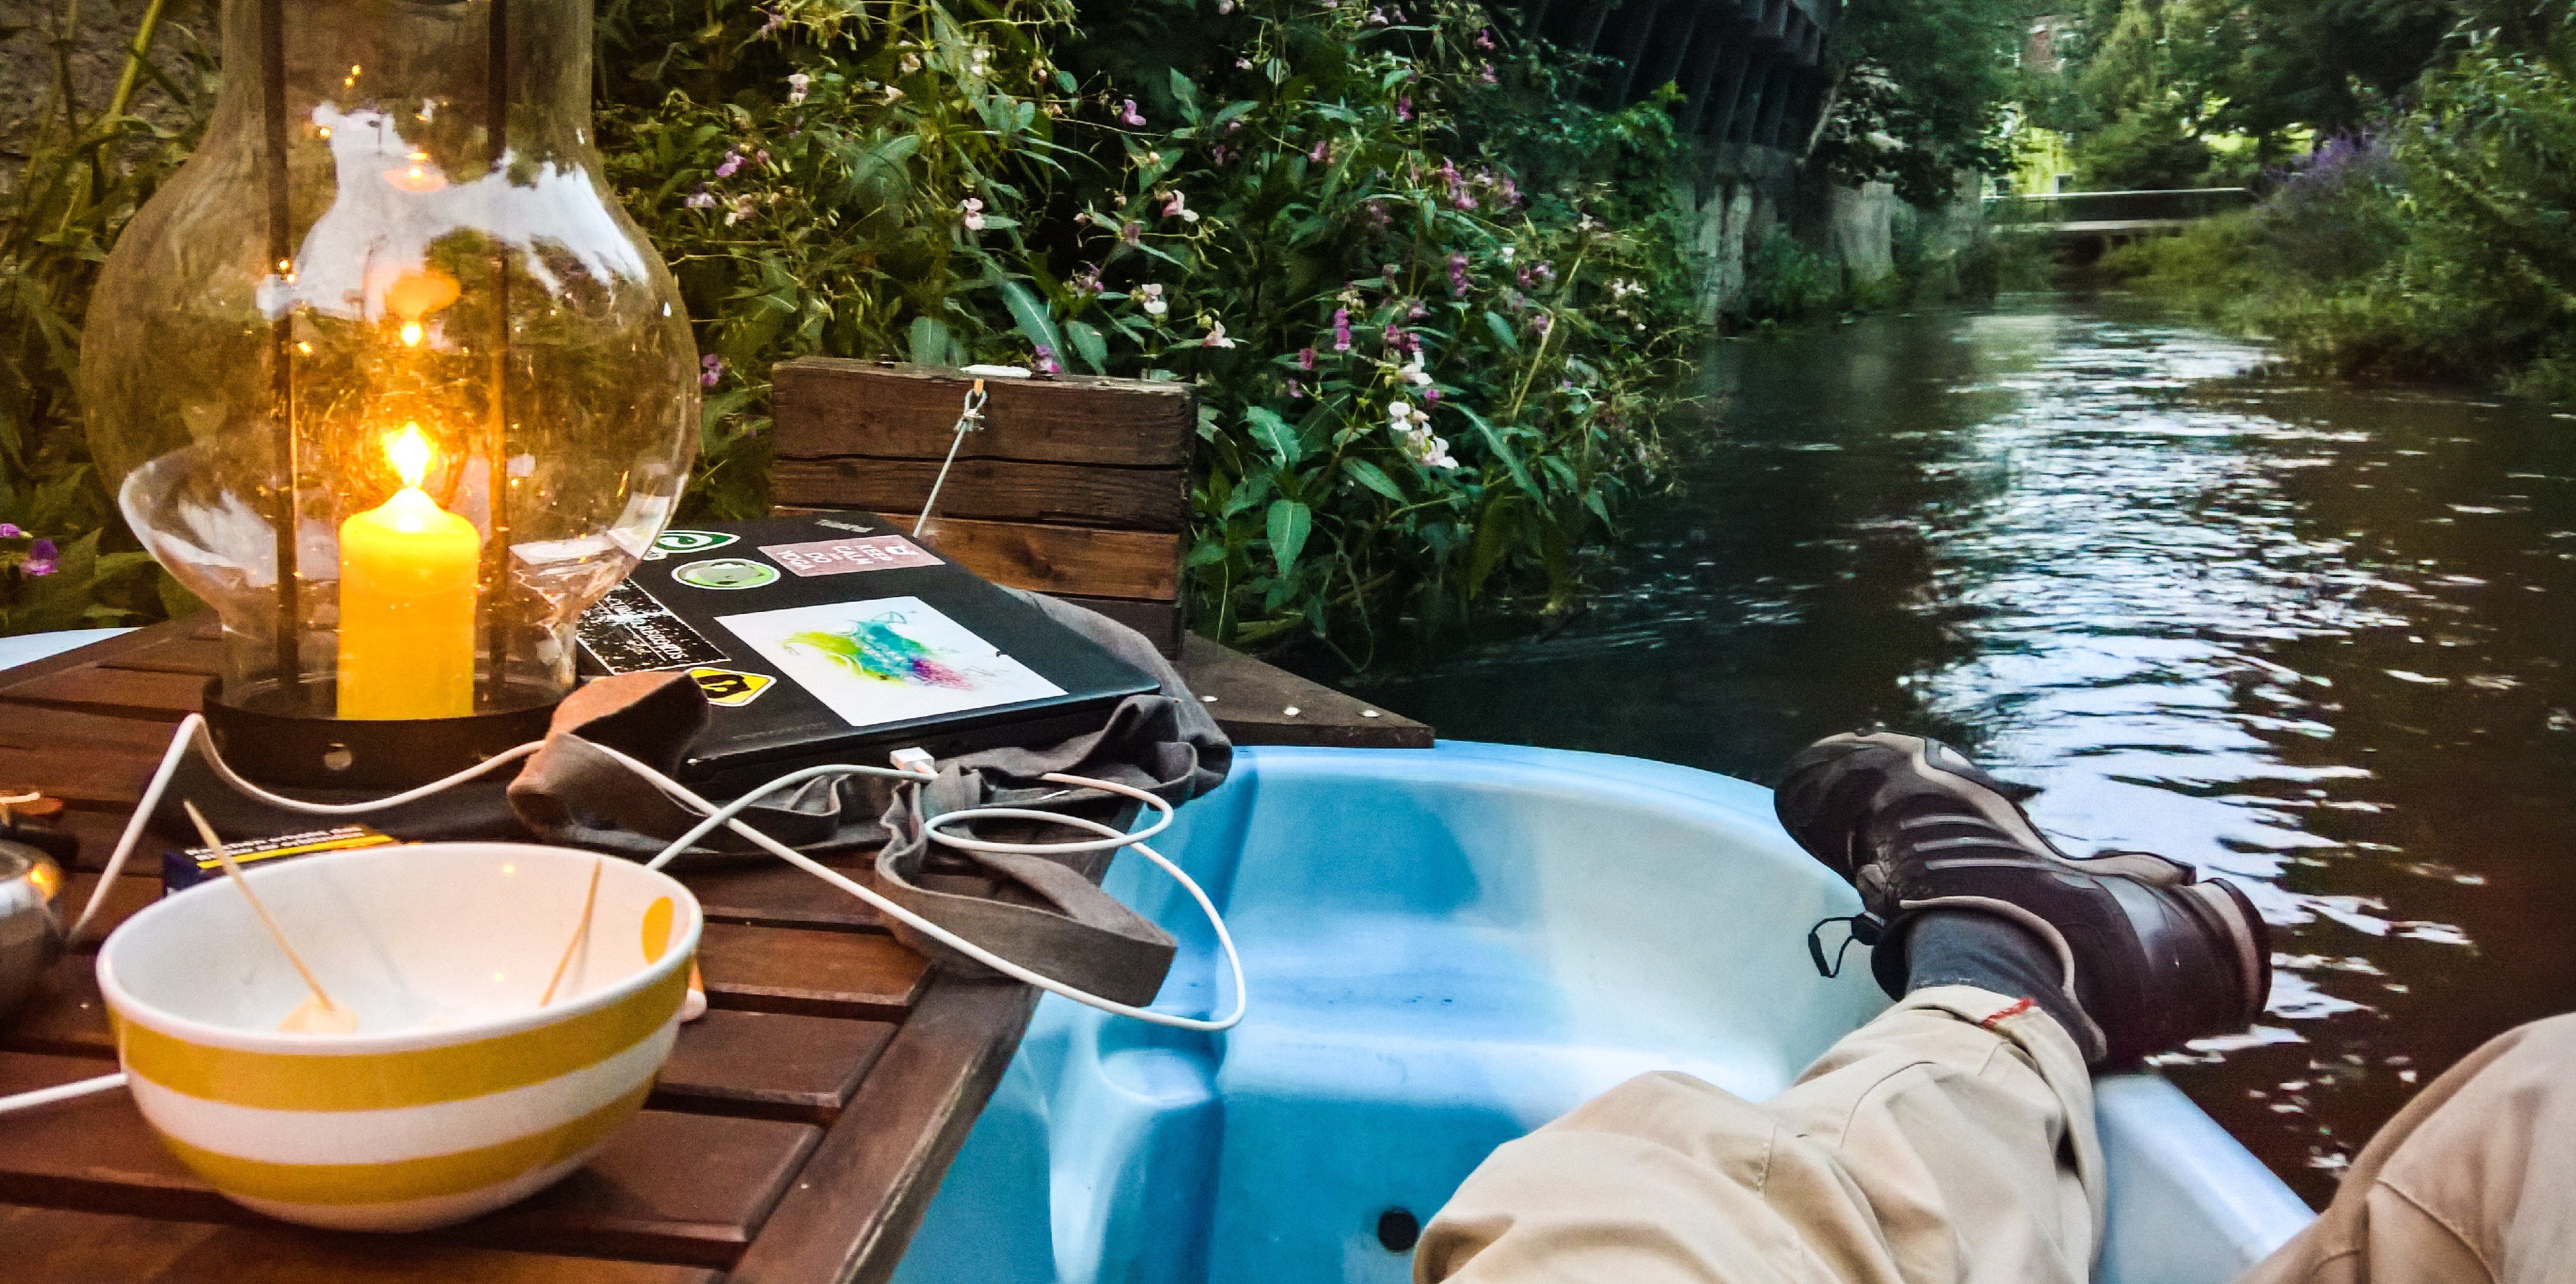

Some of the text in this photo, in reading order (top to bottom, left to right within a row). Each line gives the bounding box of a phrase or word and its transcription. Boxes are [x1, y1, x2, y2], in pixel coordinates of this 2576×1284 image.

[776, 549, 816, 570] YOGA
[805, 552, 832, 563] DO
[832, 545, 874, 565] CALM
[854, 544, 894, 562] KEEP
